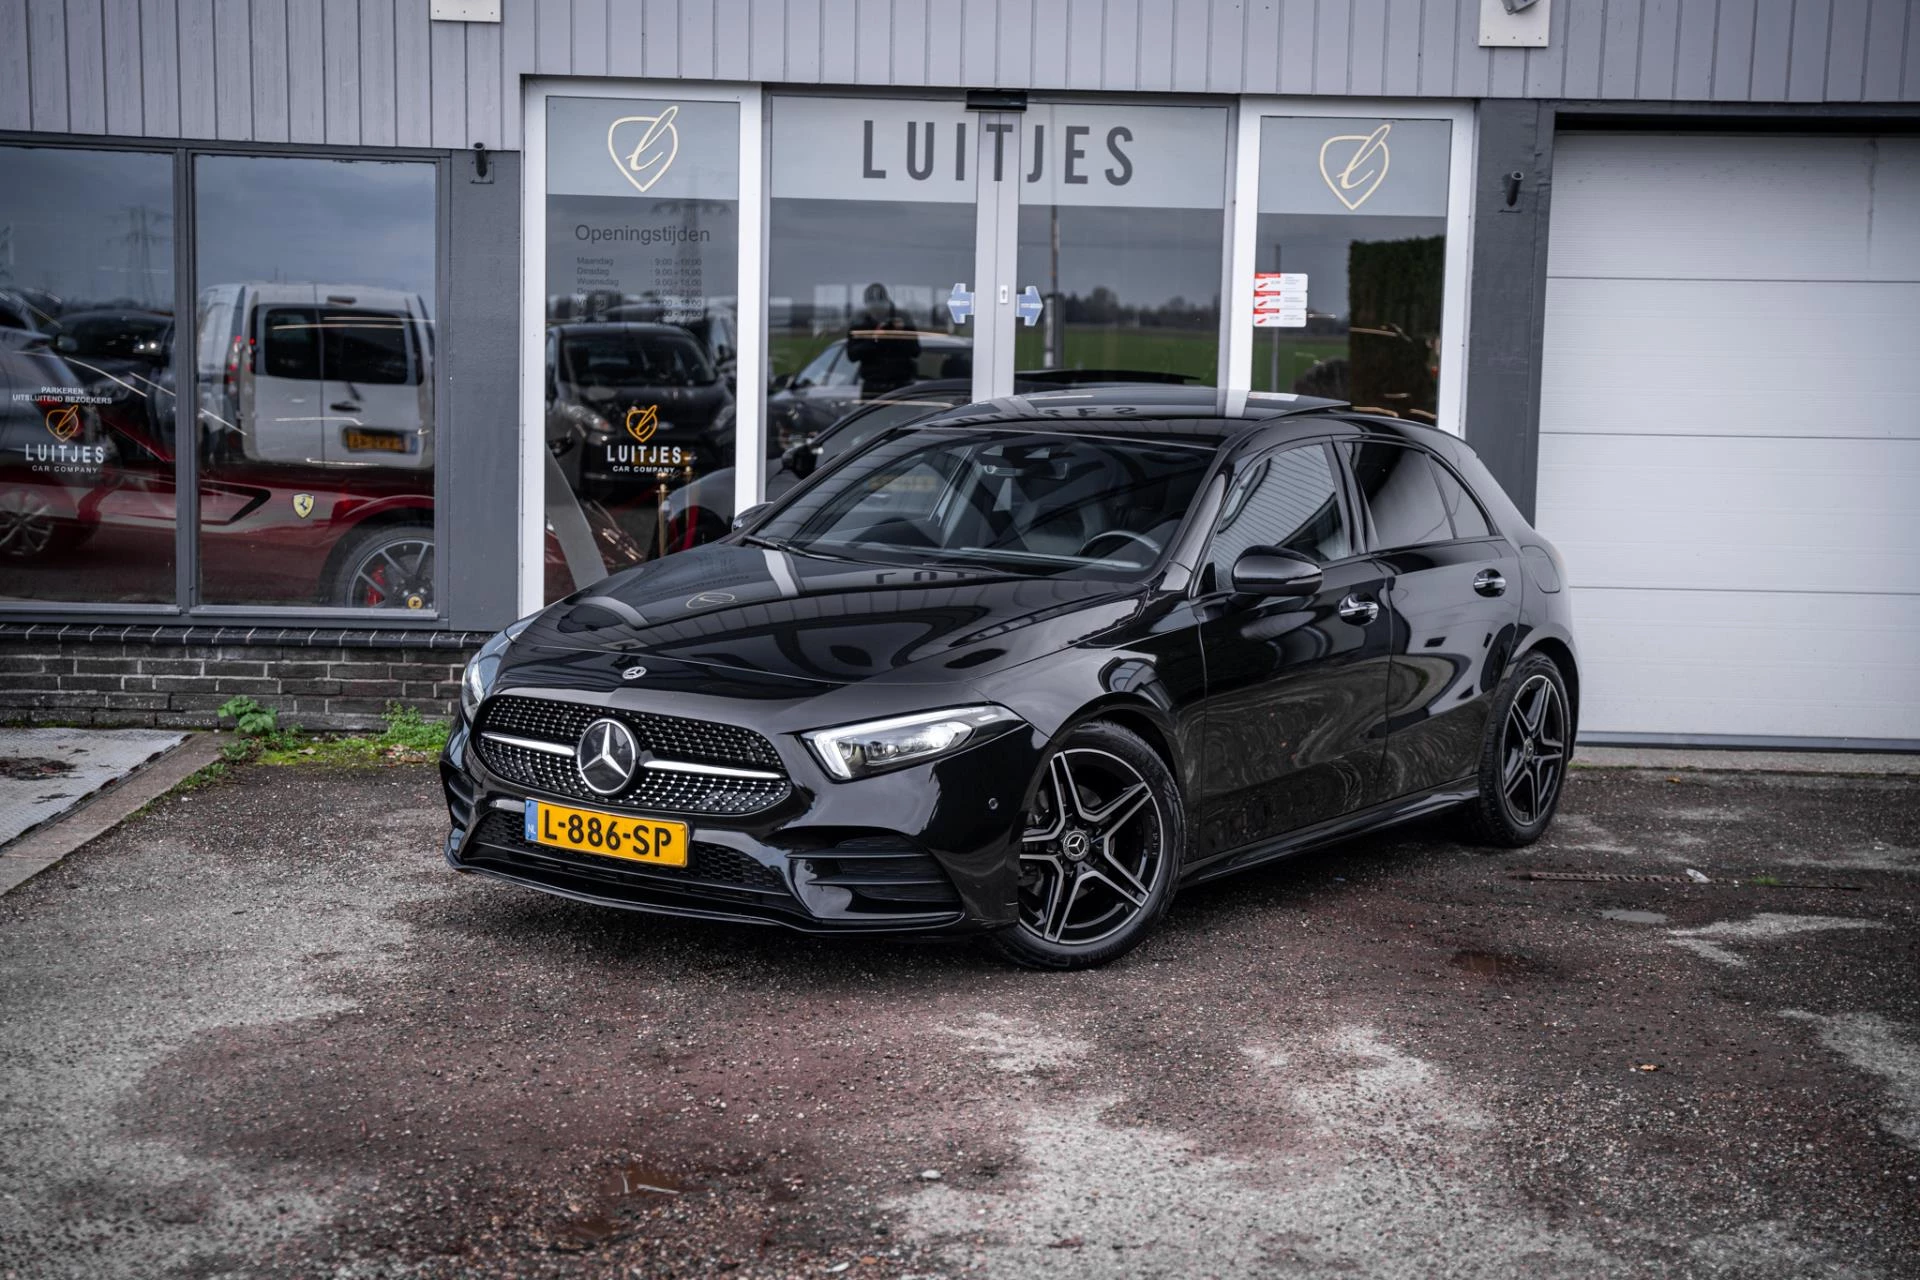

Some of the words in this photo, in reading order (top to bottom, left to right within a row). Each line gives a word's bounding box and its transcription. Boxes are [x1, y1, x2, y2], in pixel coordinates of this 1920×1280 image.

[863, 120, 1133, 186] LUITJES
[575, 224, 710, 245] Openingstijden
[41, 386, 83, 395] PARKEREN
[12, 394, 63, 403] UITSLUITEND
[65, 395, 112, 405] BEZOEKERS
[25, 443, 104, 464] LUITJES
[607, 445, 682, 464] LUITJES
[31, 465, 50, 473] CAR
[54, 465, 98, 474] COMPANY
[612, 465, 630, 473] CAR
[633, 465, 675, 474] COMPANY
[527, 823, 536, 834] NL
[544, 809, 672, 857] L-886-SP
